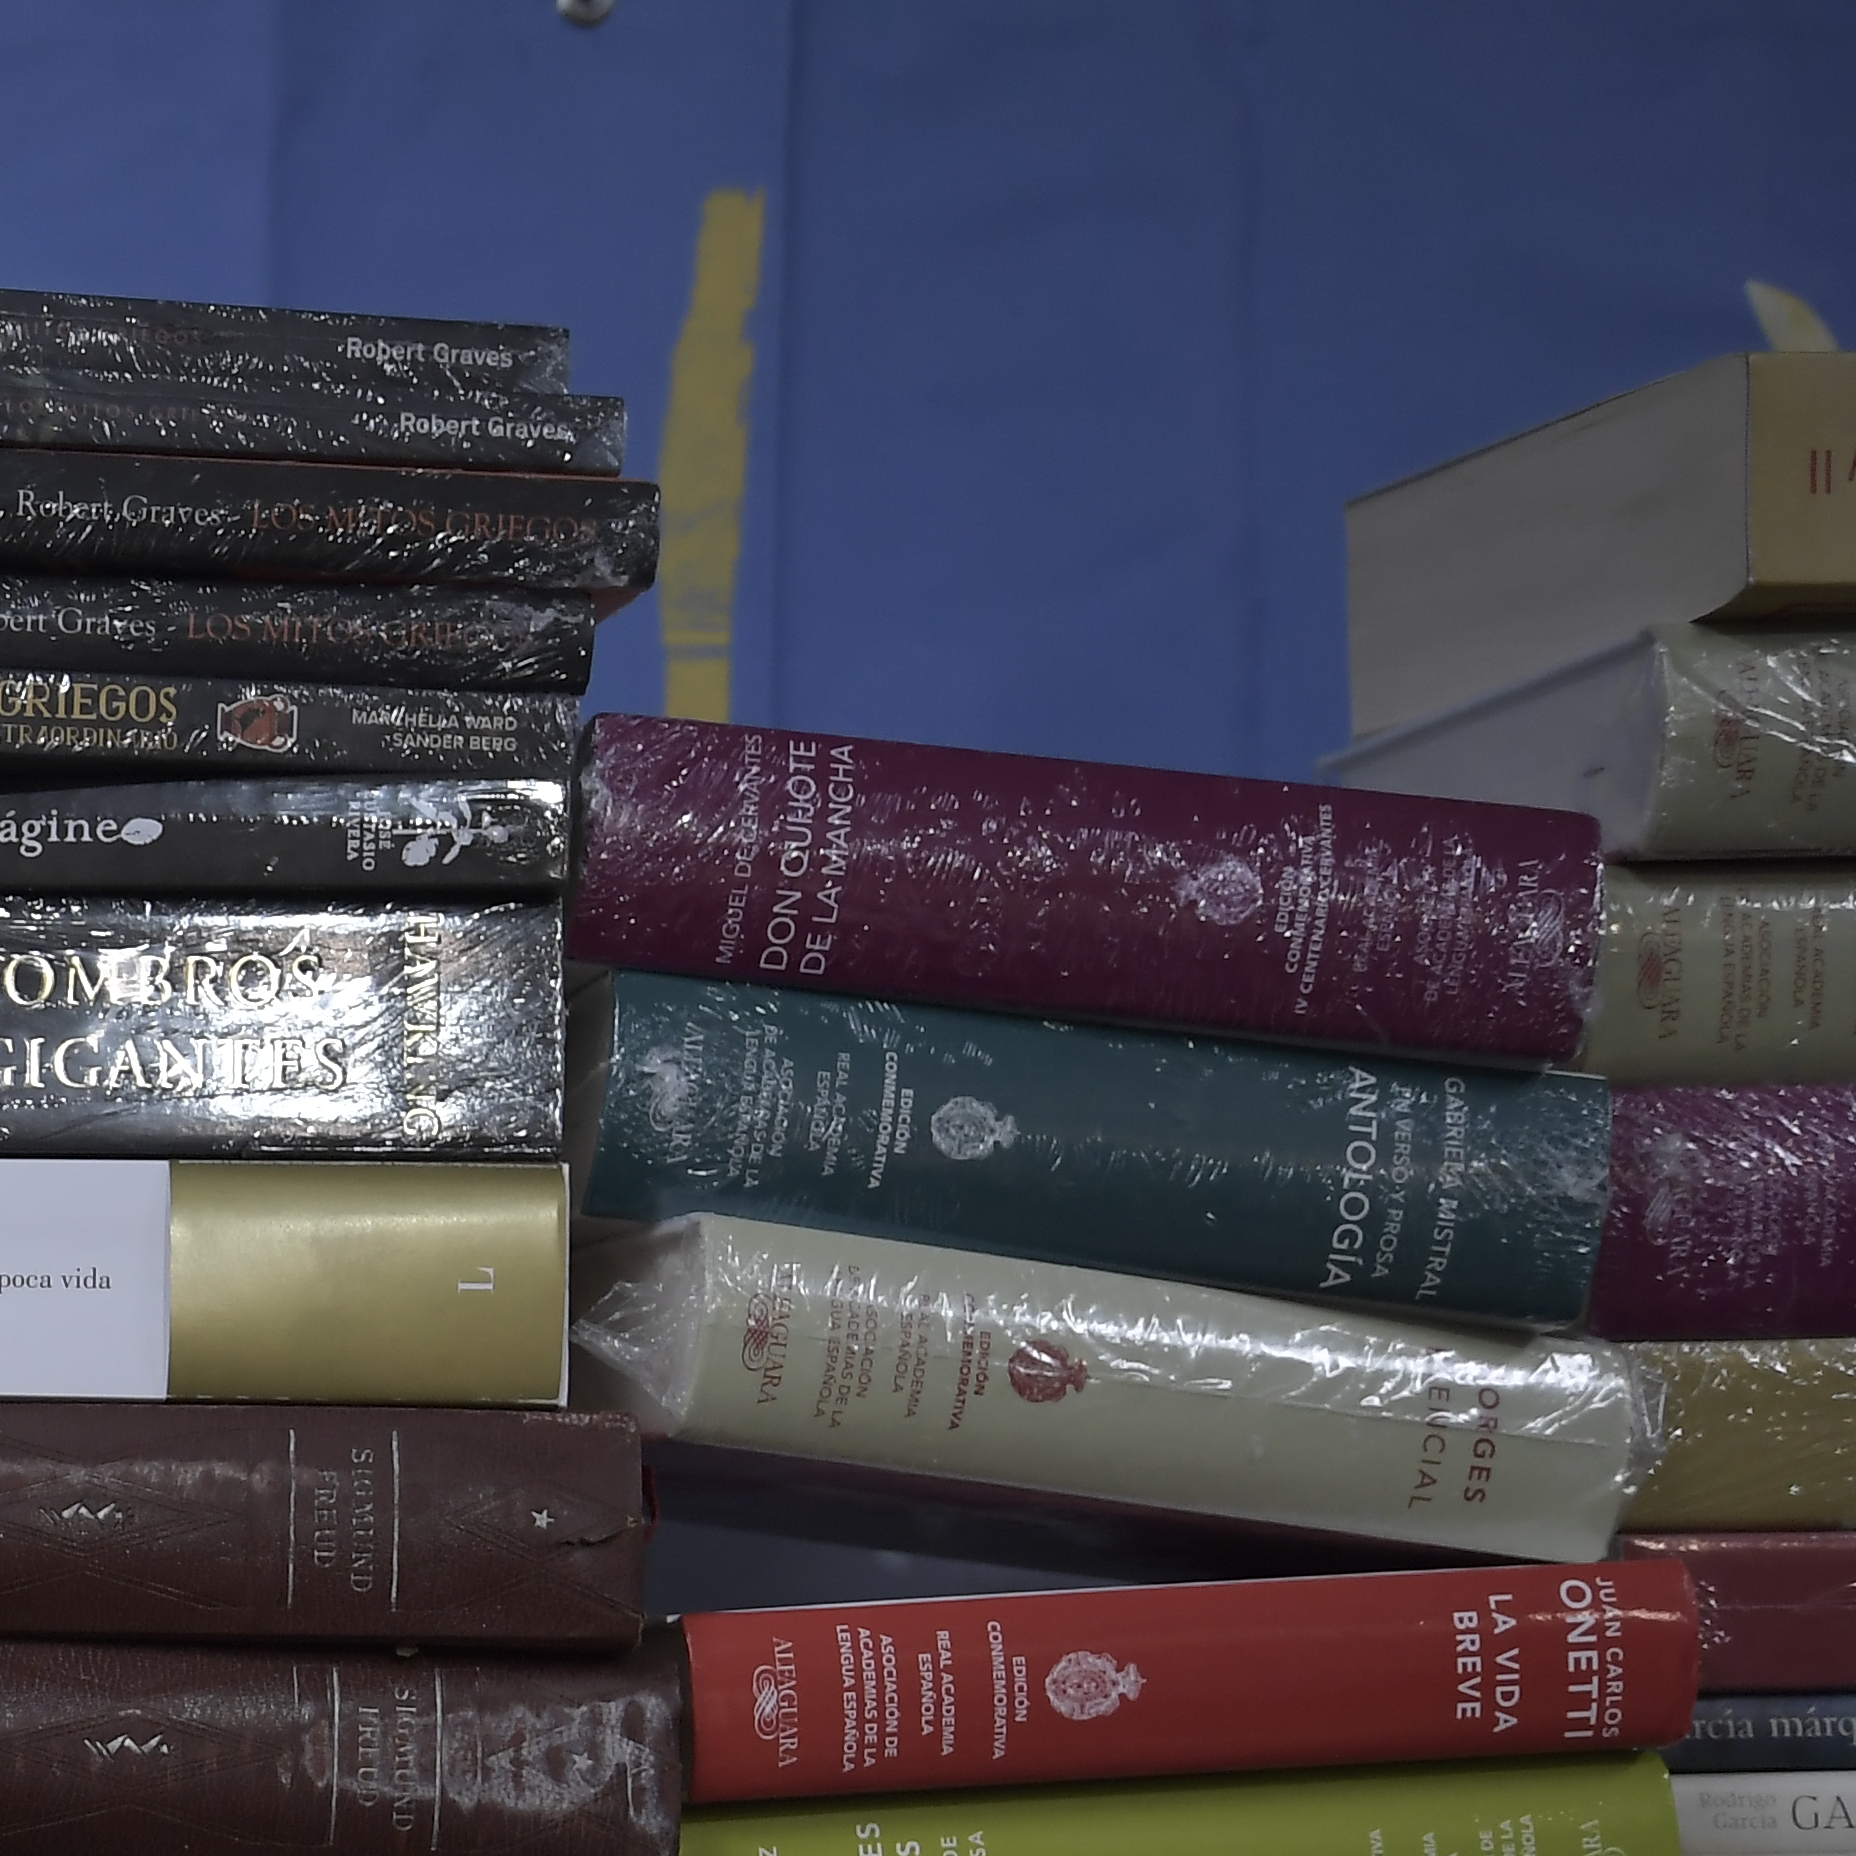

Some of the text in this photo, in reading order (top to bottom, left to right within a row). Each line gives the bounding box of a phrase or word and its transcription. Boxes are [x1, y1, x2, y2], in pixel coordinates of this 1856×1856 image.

[346, 337, 513, 368] Robert Graves
[759, 740, 821, 971] DON QUIJOTE
[799, 744, 855, 975] DE LA MANCHA
[1319, 1066, 1378, 1288] ANTOLOGÍA
[60, 1265, 112, 1290] vida
[1453, 1611, 1482, 1720] BREVE
[1488, 1594, 1521, 1733] LA VIDA
[1559, 1579, 1599, 1738] ONETTI
[1595, 1576, 1624, 1738] JUAN CARLOS
